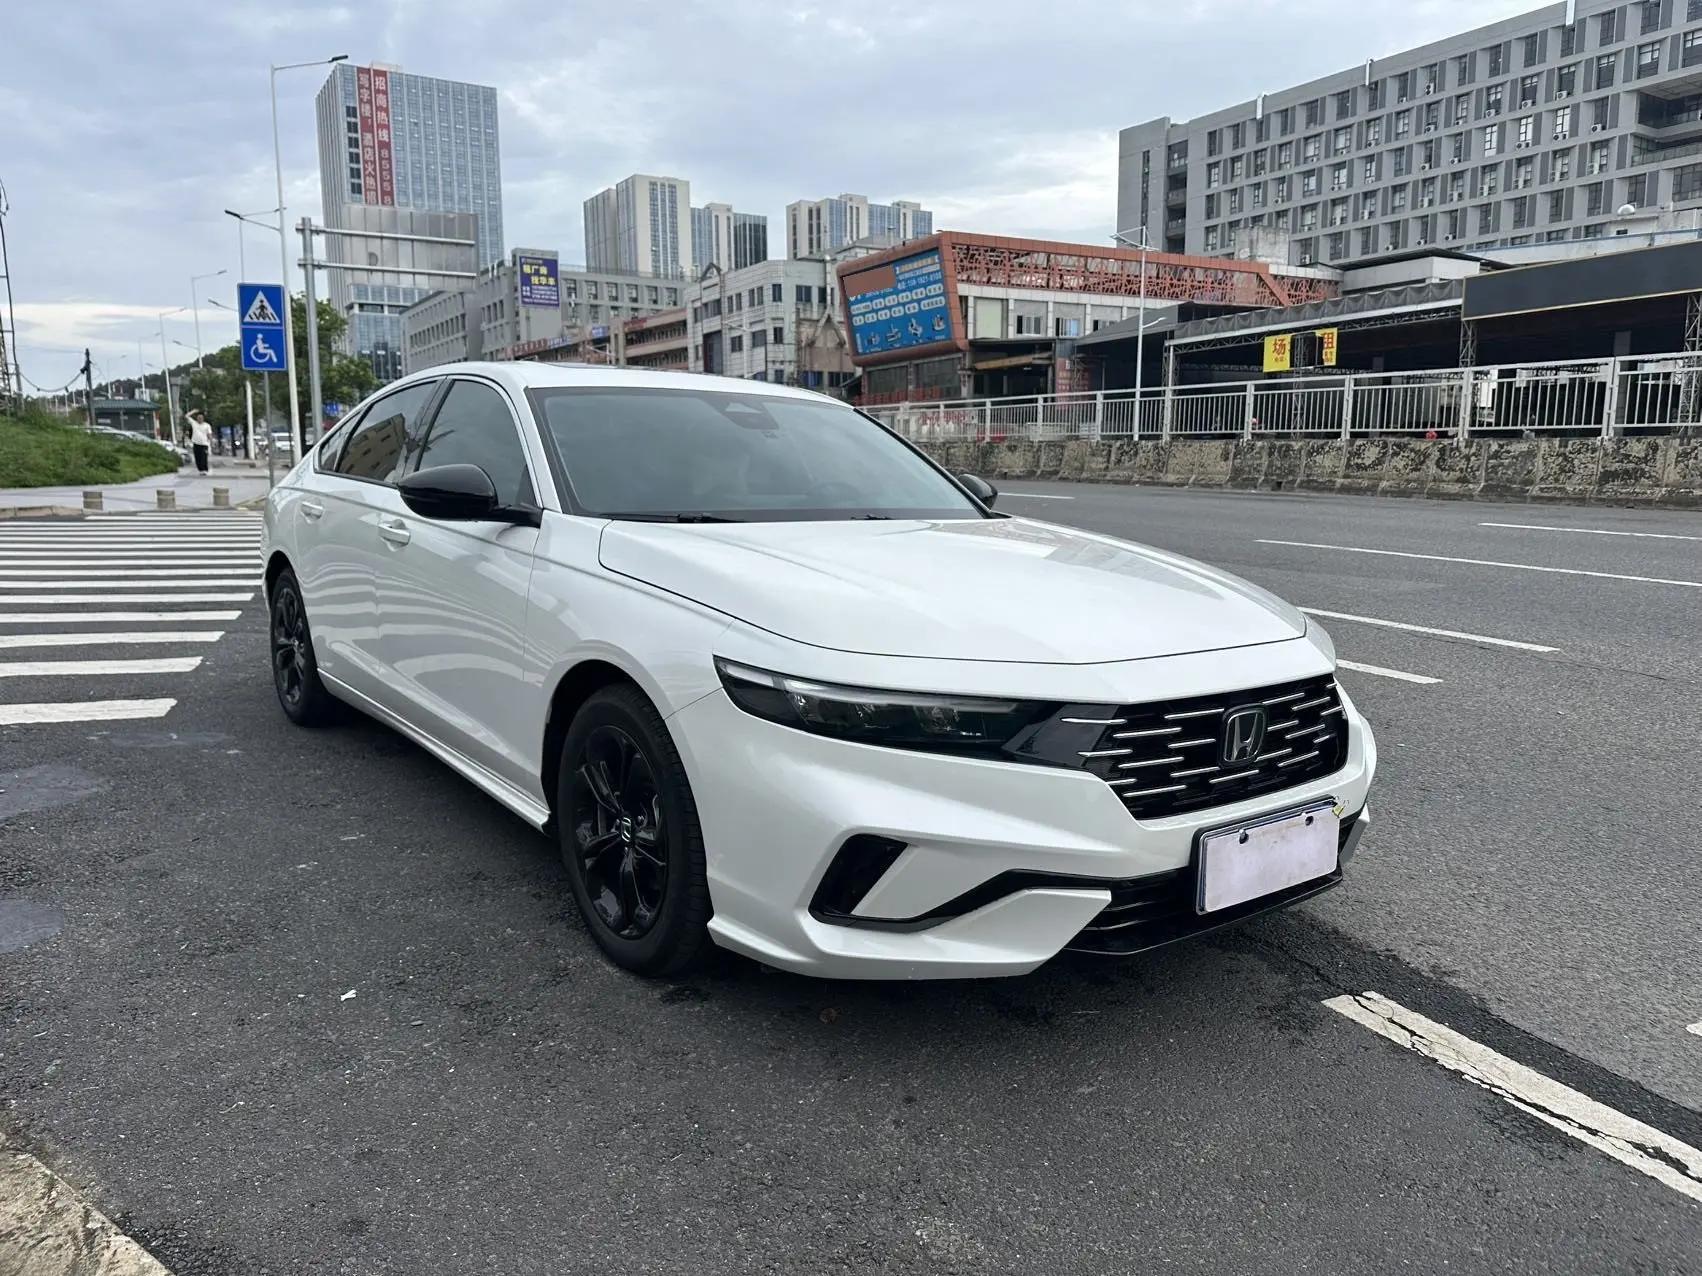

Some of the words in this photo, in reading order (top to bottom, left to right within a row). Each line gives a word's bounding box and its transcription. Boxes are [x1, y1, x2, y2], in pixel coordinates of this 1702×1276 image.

[374, 76, 390, 143] 招商热线
[1272, 338, 1286, 356] 场
